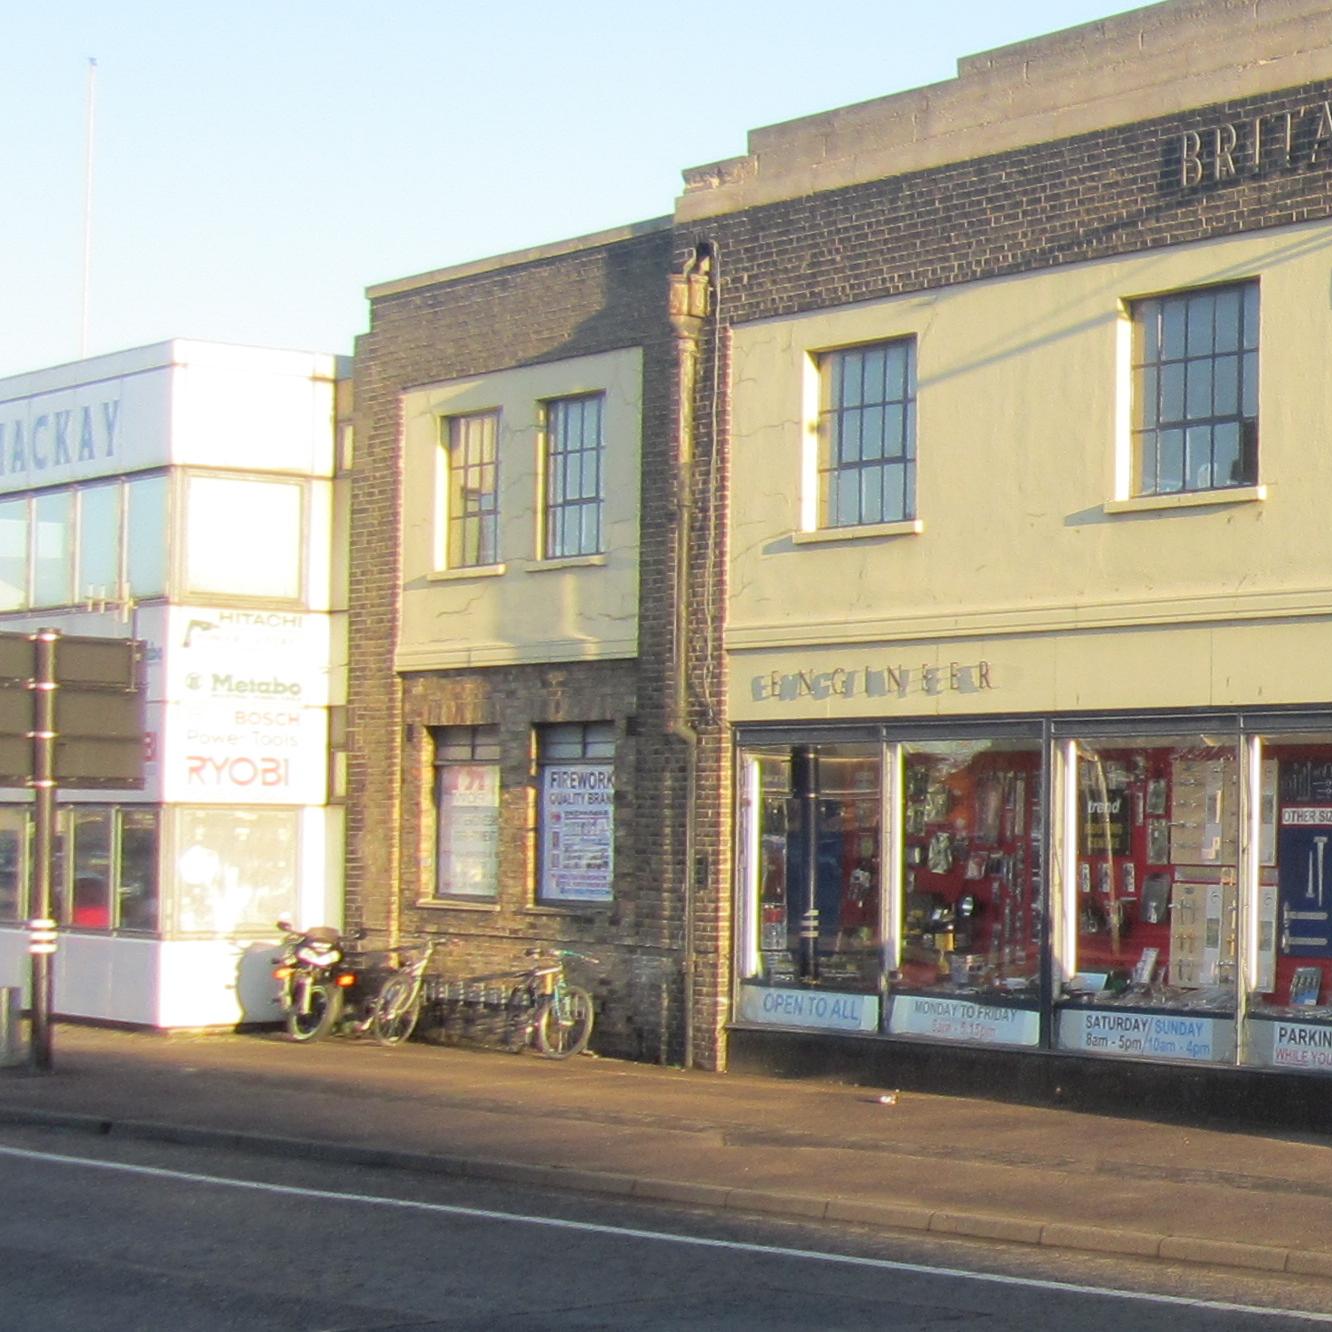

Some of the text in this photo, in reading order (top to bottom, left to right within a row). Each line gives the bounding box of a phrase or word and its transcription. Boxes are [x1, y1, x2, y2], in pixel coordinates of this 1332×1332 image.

[0, 399, 120, 477] ACKAY
[219, 611, 303, 628] HITACHI
[211, 673, 302, 695] Metabo
[770, 660, 993, 697] ENGINEER
[234, 710, 300, 726] BOSCH
[186, 755, 290, 787] RYOBI
[1283, 810, 1317, 823] OTHER
[762, 993, 801, 1014] OPEN
[808, 995, 827, 1017] TO
[914, 1000, 1017, 1023] MONDAY TO FRIDAY
[1154, 1019, 1205, 1037] SUNDAY
[1086, 1033, 1108, 1048] 8am
[1118, 1035, 1142, 1053] 5pm
[1186, 1039, 1210, 1057] 4pm
[1275, 1048, 1309, 1064] WHILE
